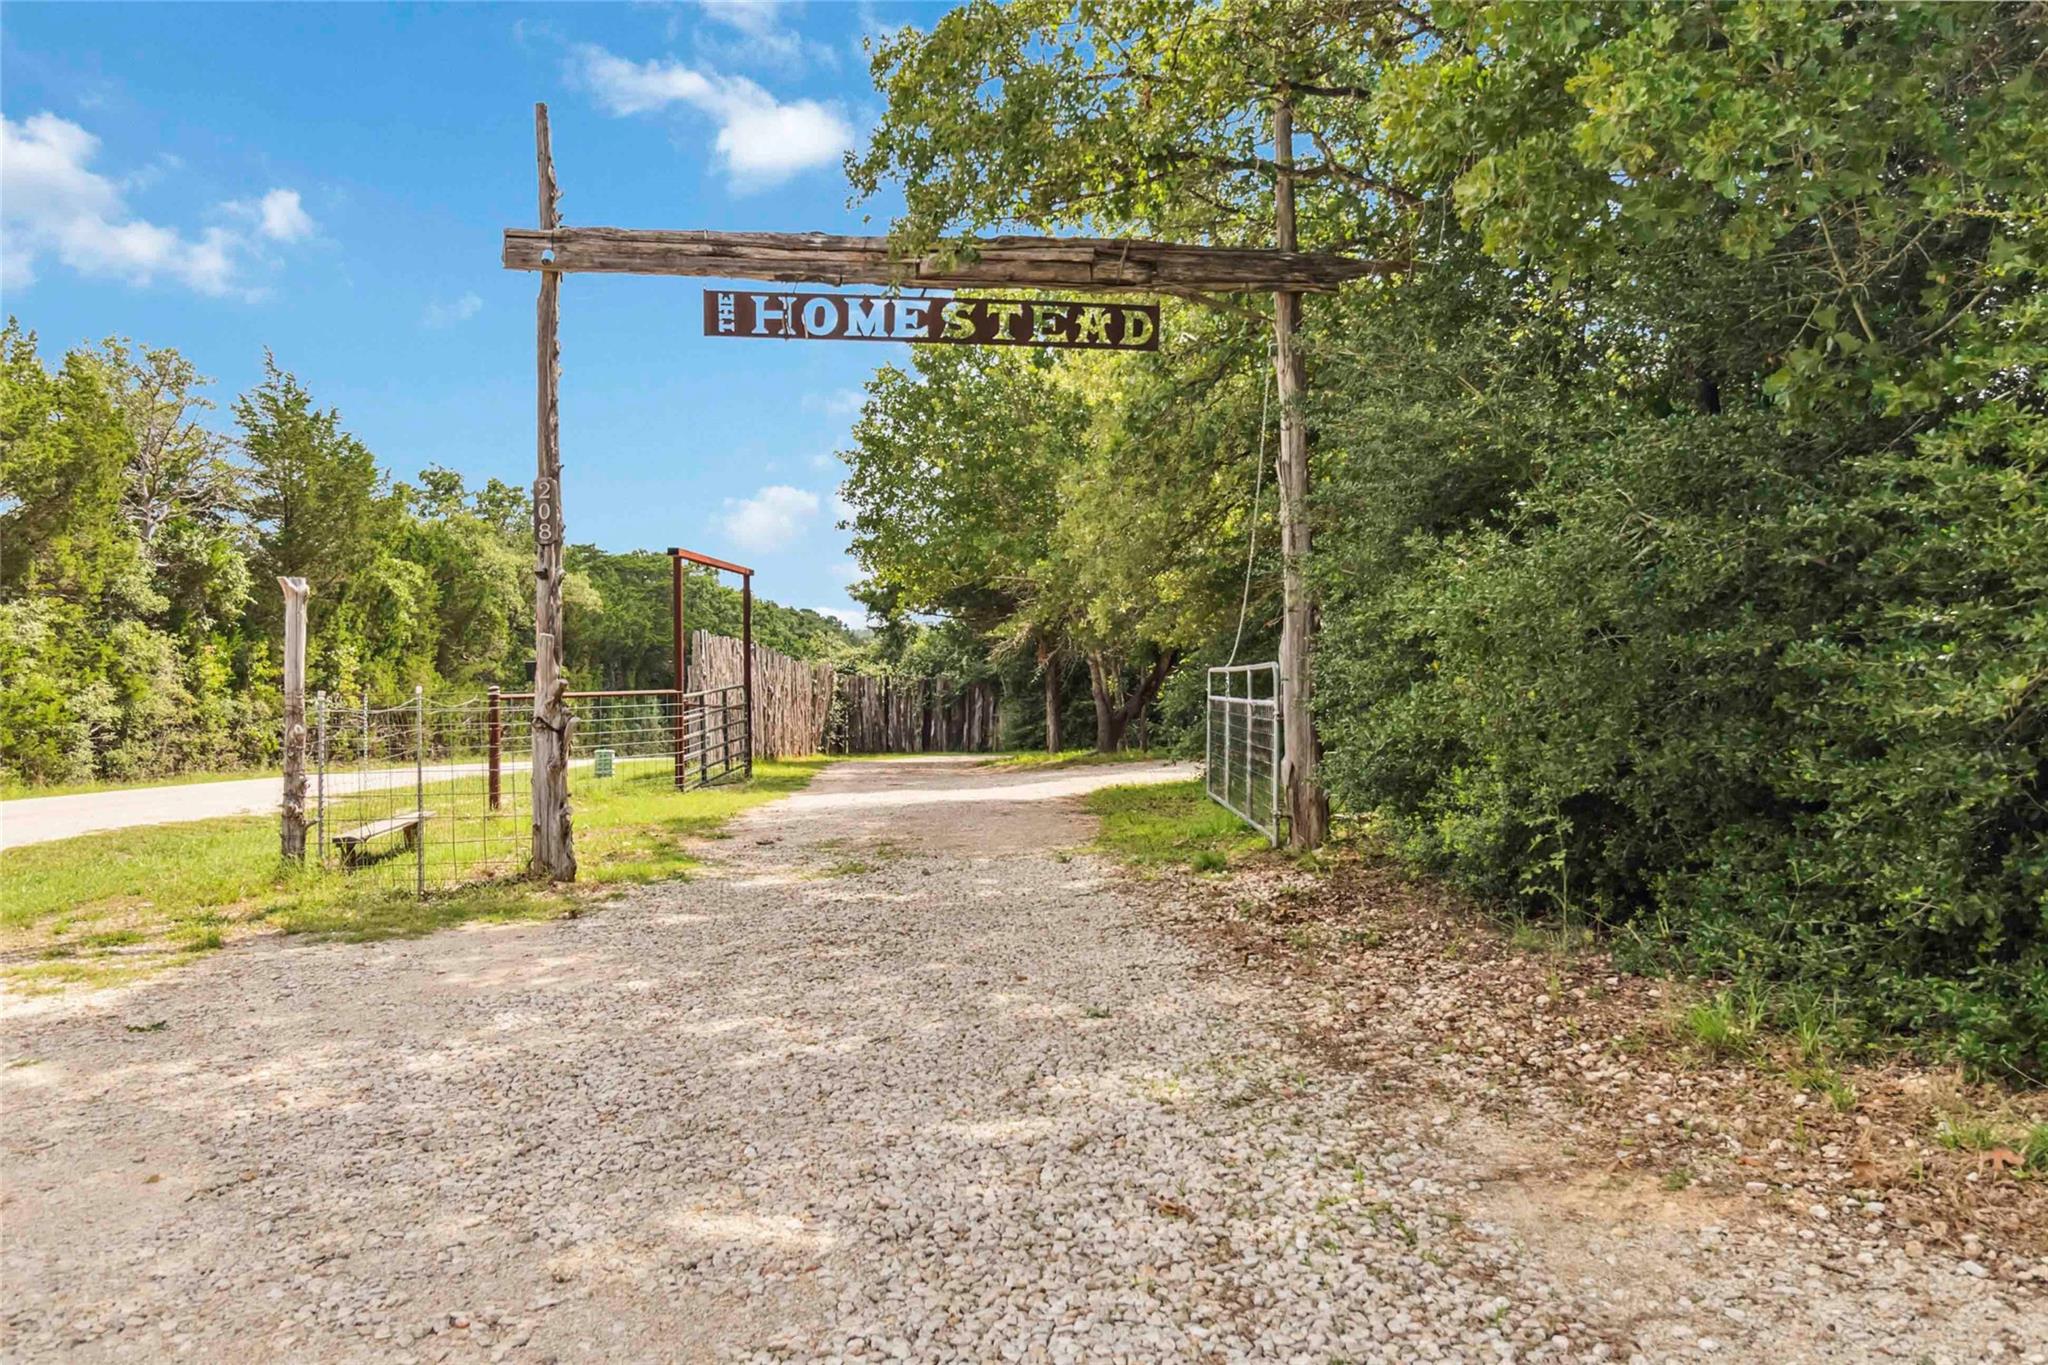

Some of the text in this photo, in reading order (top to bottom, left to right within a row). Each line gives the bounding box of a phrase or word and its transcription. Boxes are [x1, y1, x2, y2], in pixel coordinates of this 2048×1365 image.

[718, 292, 1155, 346] THE HOMESTEAD
[538, 481, 552, 540] 208
